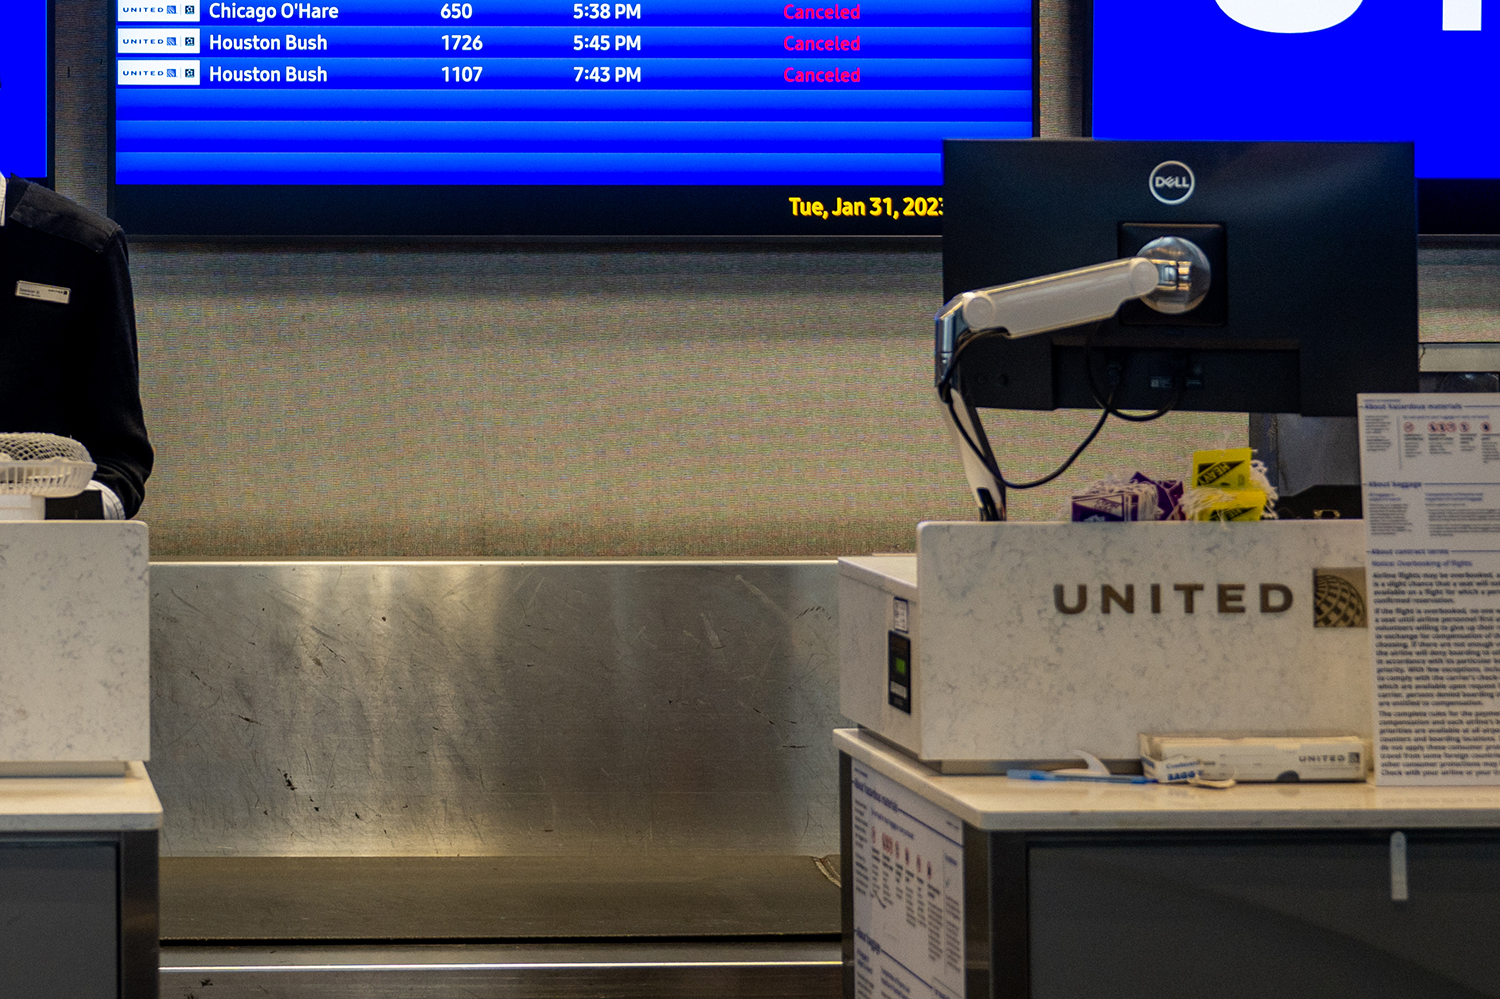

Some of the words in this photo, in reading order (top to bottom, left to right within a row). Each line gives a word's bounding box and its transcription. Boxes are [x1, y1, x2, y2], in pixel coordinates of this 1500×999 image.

[210, 3, 276, 22] Chicago
[281, 3, 338, 18] O'Hare
[441, 3, 472, 18] 650
[574, 4, 610, 19] 5:38
[615, 4, 640, 18] PM
[784, 4, 860, 19] Canceled
[210, 35, 280, 49] Houston
[286, 34, 327, 49] Bush
[442, 35, 482, 50] 1726
[574, 35, 610, 50] 5:45
[616, 35, 640, 50] PM
[784, 36, 860, 51] Canceled
[210, 66, 280, 81] Houston
[286, 66, 327, 81] Bush
[442, 67, 482, 81] 1107
[574, 67, 610, 82] 7:43
[616, 67, 640, 82] PM
[784, 67, 860, 82] Canceled
[1155, 176, 1190, 189] DELL
[789, 197, 828, 219] Tue,
[832, 197, 866, 216] Jan
[870, 197, 899, 219] 31,
[1392, 481, 1422, 489] baggage
[1396, 560, 1441, 568] Overbooking
[1450, 560, 1473, 568] flights
[1054, 583, 1293, 615] UNITED
[1299, 754, 1345, 762] UNITED
